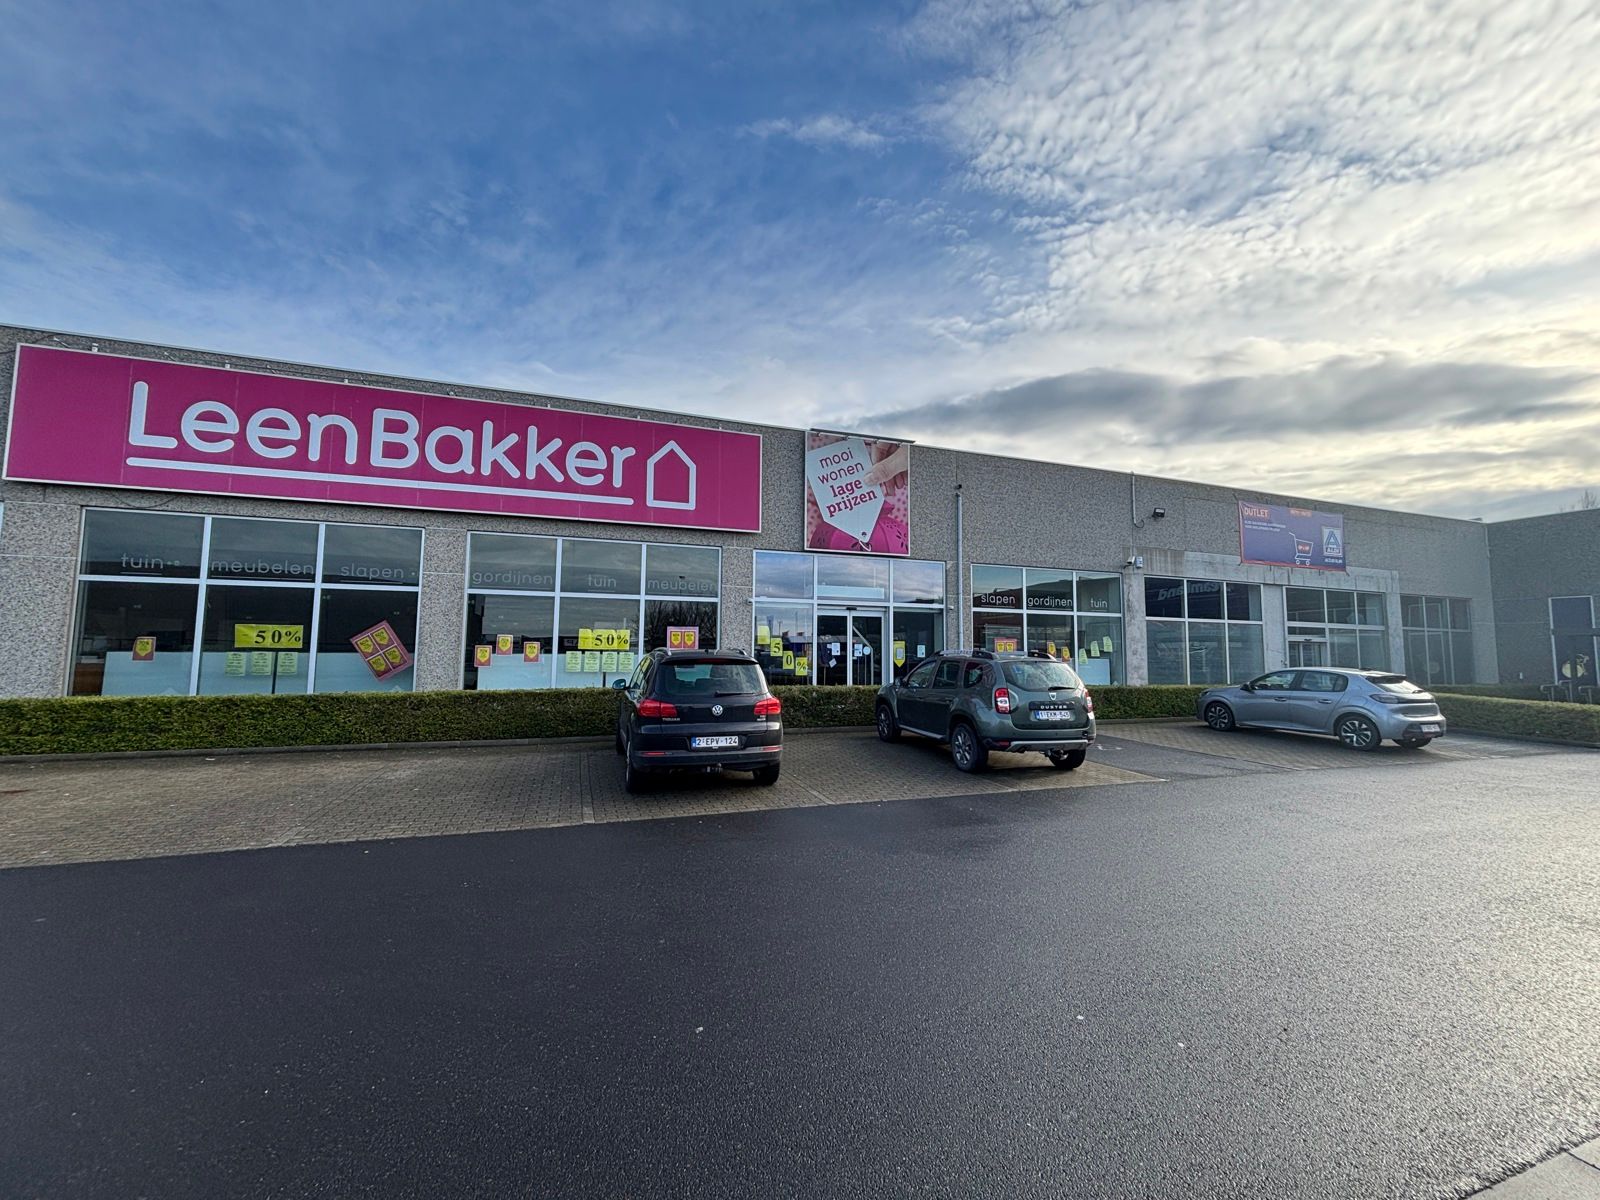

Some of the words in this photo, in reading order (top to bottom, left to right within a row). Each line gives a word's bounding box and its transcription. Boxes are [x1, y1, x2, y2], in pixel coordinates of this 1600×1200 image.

[128, 380, 636, 488] LeenBakker
[819, 447, 854, 469] mooi
[818, 462, 864, 485] wonen
[829, 479, 863, 498] lage
[826, 489, 878, 518] prijzen
[1244, 507, 1269, 518] OUTLET
[121, 553, 164, 569] tuin
[211, 559, 314, 575] meubelen
[340, 563, 404, 580] slapen
[471, 569, 554, 587] gordijnen
[588, 574, 617, 589] tuin
[647, 578, 717, 593] meubelen
[981, 592, 1016, 606] slapen
[1027, 596, 1073, 608] gordijnen
[1090, 598, 1108, 608] tuin
